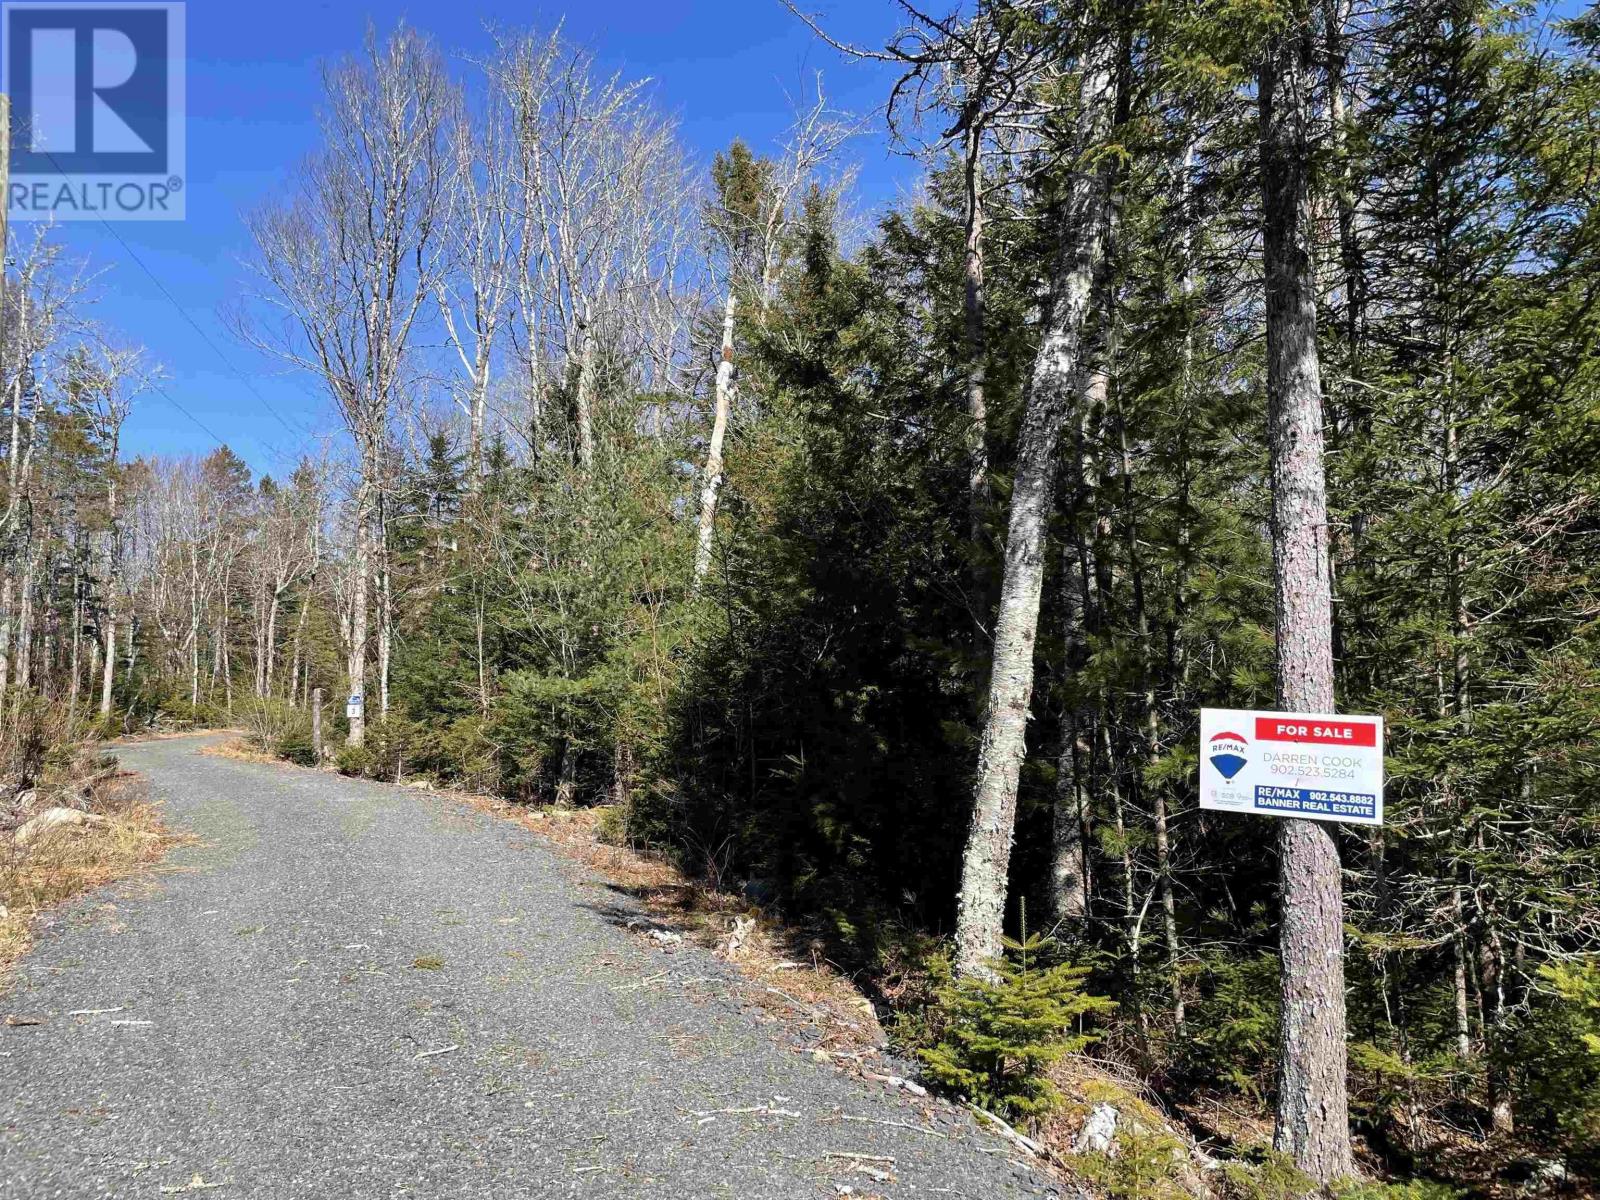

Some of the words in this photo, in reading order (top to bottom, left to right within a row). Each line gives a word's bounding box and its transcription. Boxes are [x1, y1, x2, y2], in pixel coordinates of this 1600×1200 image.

[1276, 725, 1308, 737] FOR
[1313, 727, 1353, 739] SALE
[1212, 743, 1245, 754] RE/MAX
[1263, 752, 1318, 766] DARREN
[1322, 756, 1362, 768] COOK
[1270, 764, 1355, 779] 902.523.5284
[1258, 787, 1300, 799] RE/MAX
[1309, 791, 1374, 805] 902.543.8882
[1258, 797, 1300, 809] BANNER
[1302, 801, 1331, 812] REAL
[1333, 804, 1374, 815] ESTATE
